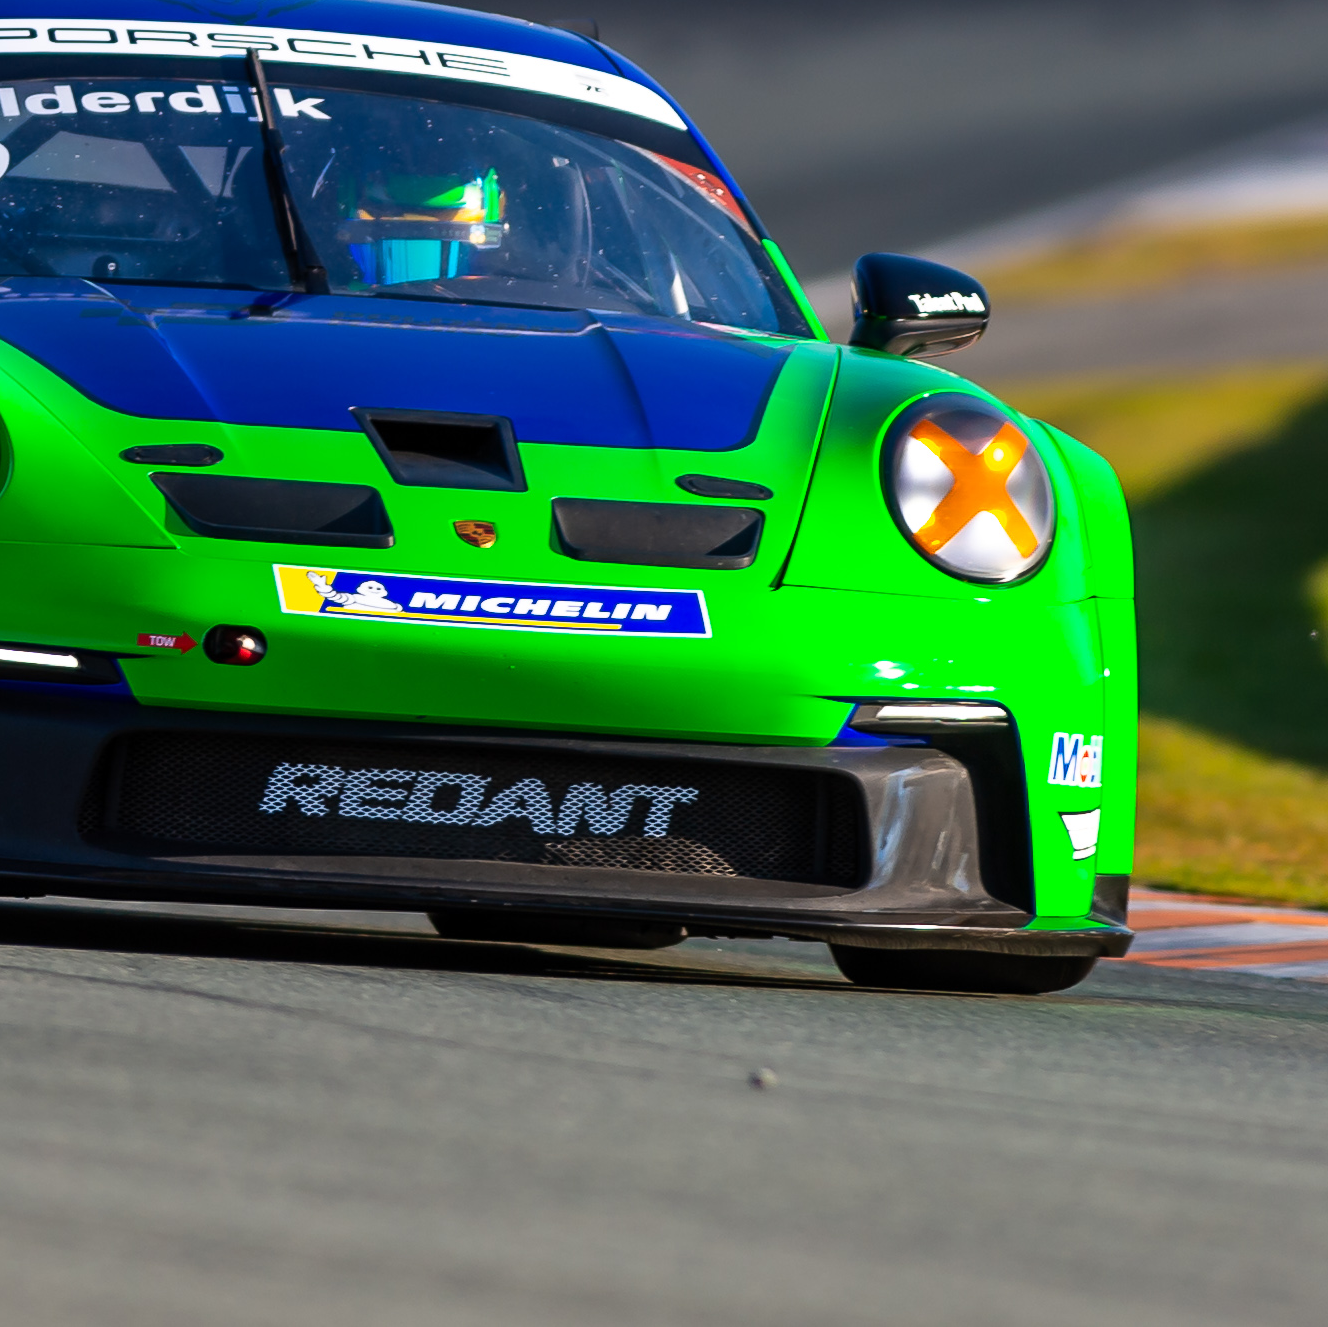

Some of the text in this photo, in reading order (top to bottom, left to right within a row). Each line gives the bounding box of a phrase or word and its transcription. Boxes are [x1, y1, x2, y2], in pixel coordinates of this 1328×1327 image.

[409, 591, 673, 621] MICHELIN
[148, 635, 177, 648] TOW
[259, 762, 700, 837] REDANT
